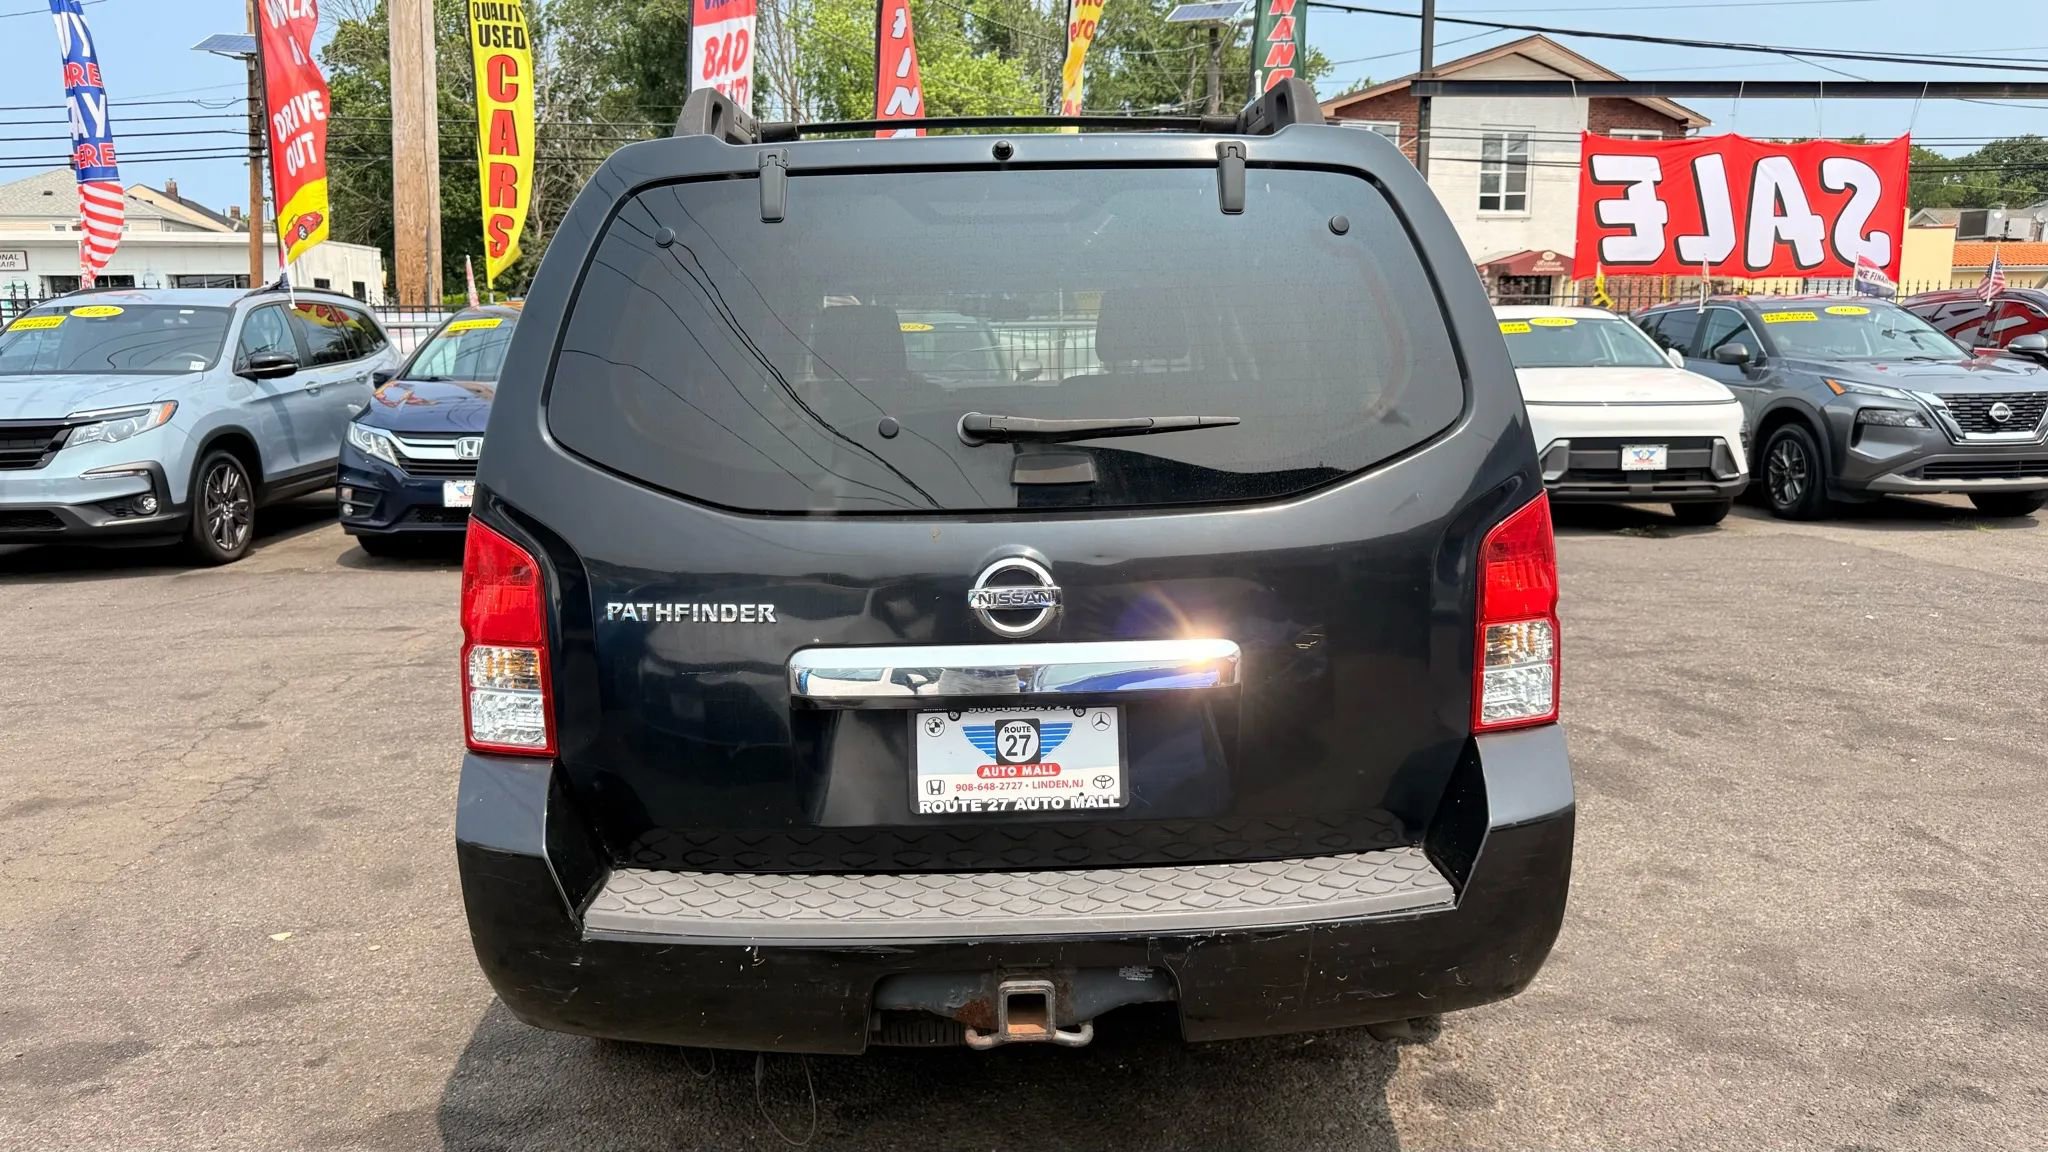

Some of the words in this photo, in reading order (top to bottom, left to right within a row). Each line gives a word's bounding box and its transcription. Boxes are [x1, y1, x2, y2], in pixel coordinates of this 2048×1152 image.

[478, 24, 526, 50] USED
[703, 28, 749, 80] BAD
[273, 90, 327, 144] DRIVE
[286, 131, 317, 177] OUT
[487, 54, 519, 259] CARS
[1857, 268, 1869, 279] WE
[977, 591, 1051, 605] NISSAN
[607, 602, 777, 623] PATHFINDER
[1004, 725, 1032, 734] ROUTE
[1005, 734, 1032, 757] 27
[981, 765, 1018, 777] AUTO
[1021, 764, 1057, 776] MALL
[955, 781, 1023, 792] 908-648-2727
[919, 799, 983, 814] ROUTE
[987, 798, 1008, 812] 27
[1014, 797, 1065, 811] AUTO
[1070, 795, 1120, 809] MALL
